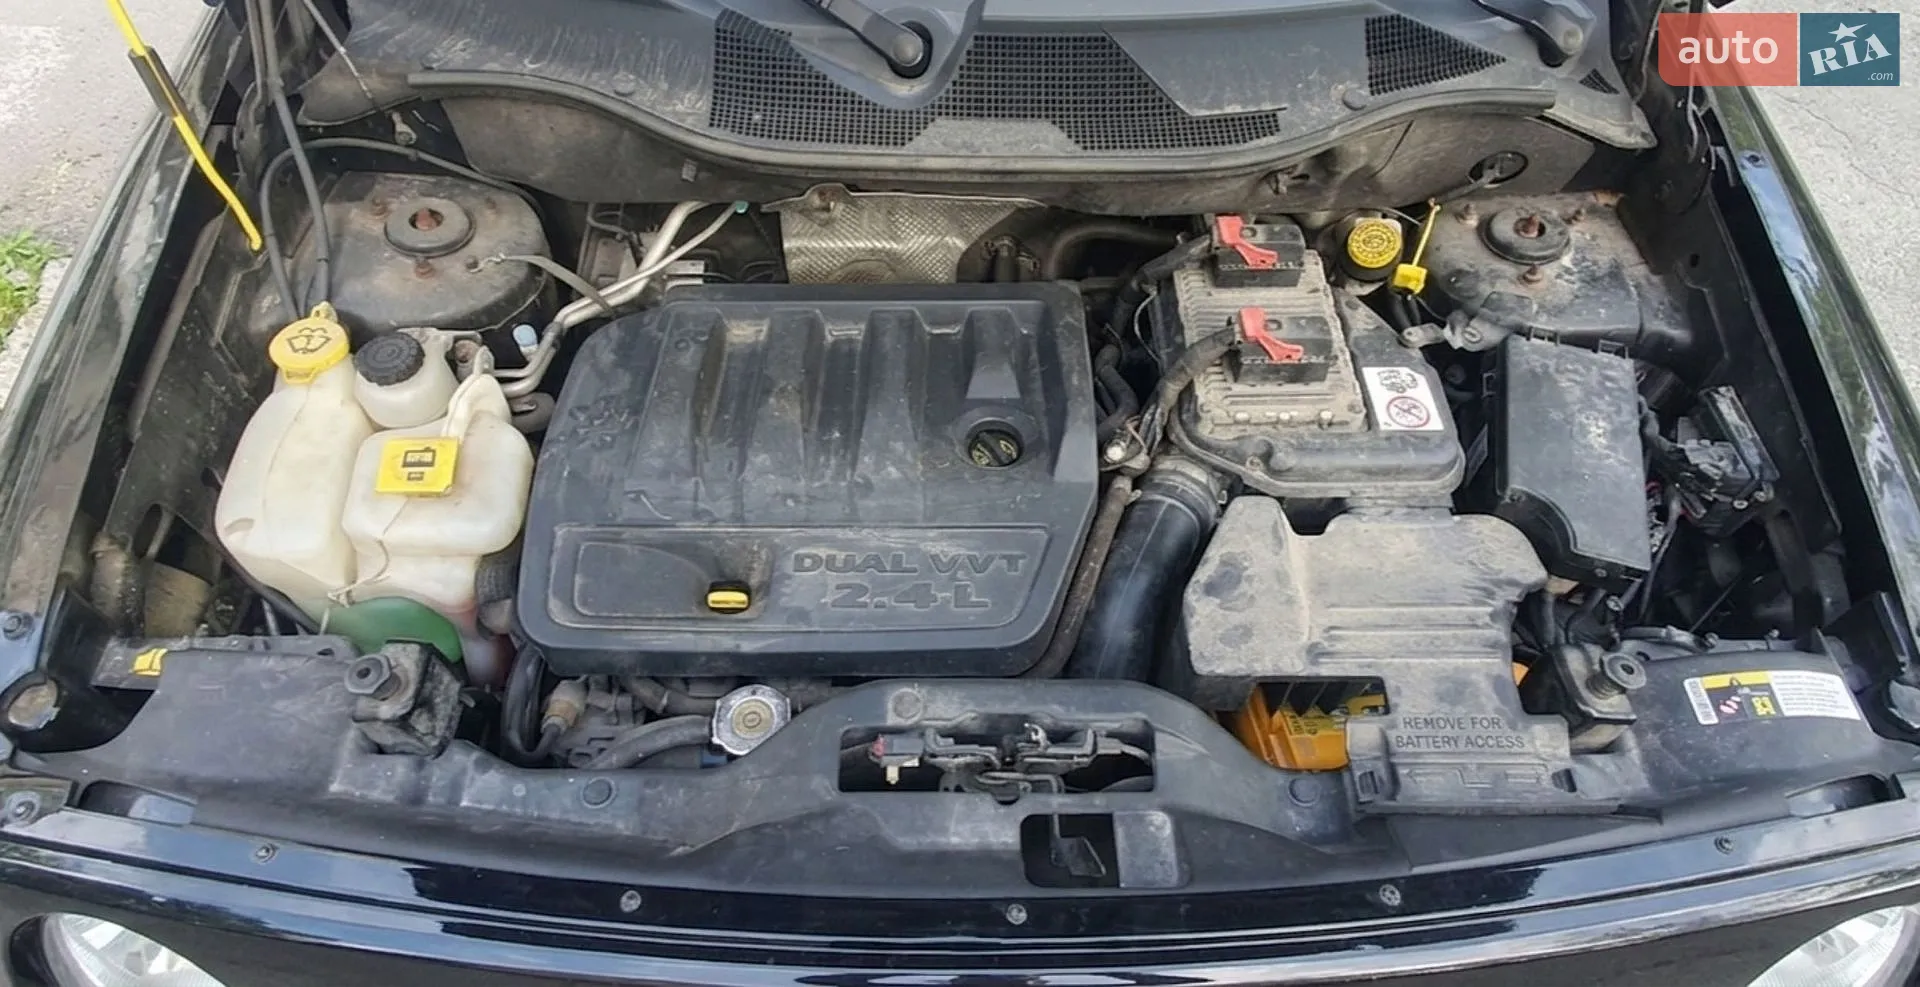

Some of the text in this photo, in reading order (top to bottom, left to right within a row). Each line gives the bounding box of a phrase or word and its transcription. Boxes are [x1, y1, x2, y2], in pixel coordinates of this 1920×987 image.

[792, 551, 1028, 574] DUAL VVT
[1402, 716, 1503, 730] REMOVE FOR
[1395, 735, 1525, 749] BATTERY ACCESS
